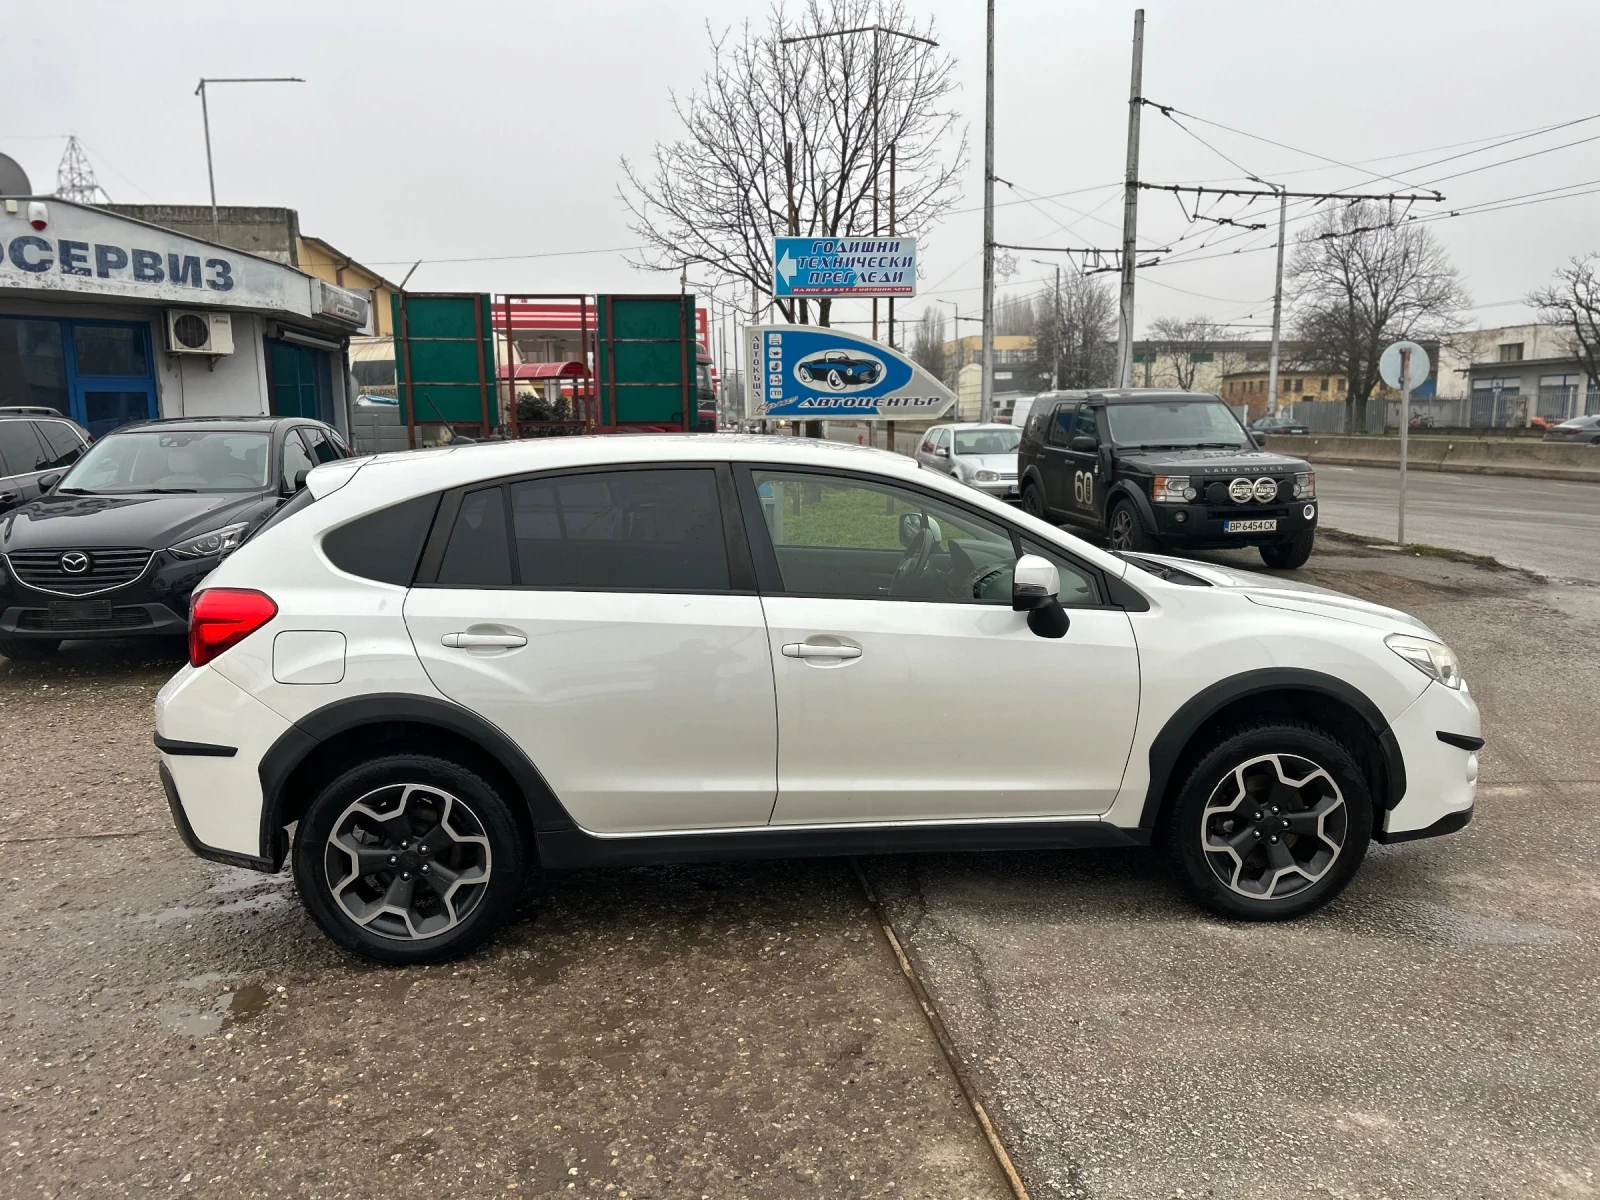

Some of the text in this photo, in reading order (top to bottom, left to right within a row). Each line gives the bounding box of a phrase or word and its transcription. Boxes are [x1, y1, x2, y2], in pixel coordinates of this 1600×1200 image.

[812, 241, 900, 253] ГОДИШНИ
[0, 235, 234, 292] СЕРВИЗ
[799, 256, 913, 268] ТЕХНИЧЕСКИ
[809, 271, 903, 283] ПРЕГЛЕДИ
[798, 397, 941, 408] АВТОЦЕНТЪР
[1075, 470, 1093, 505] 60
[1229, 521, 1275, 531] BP 6454 CK
